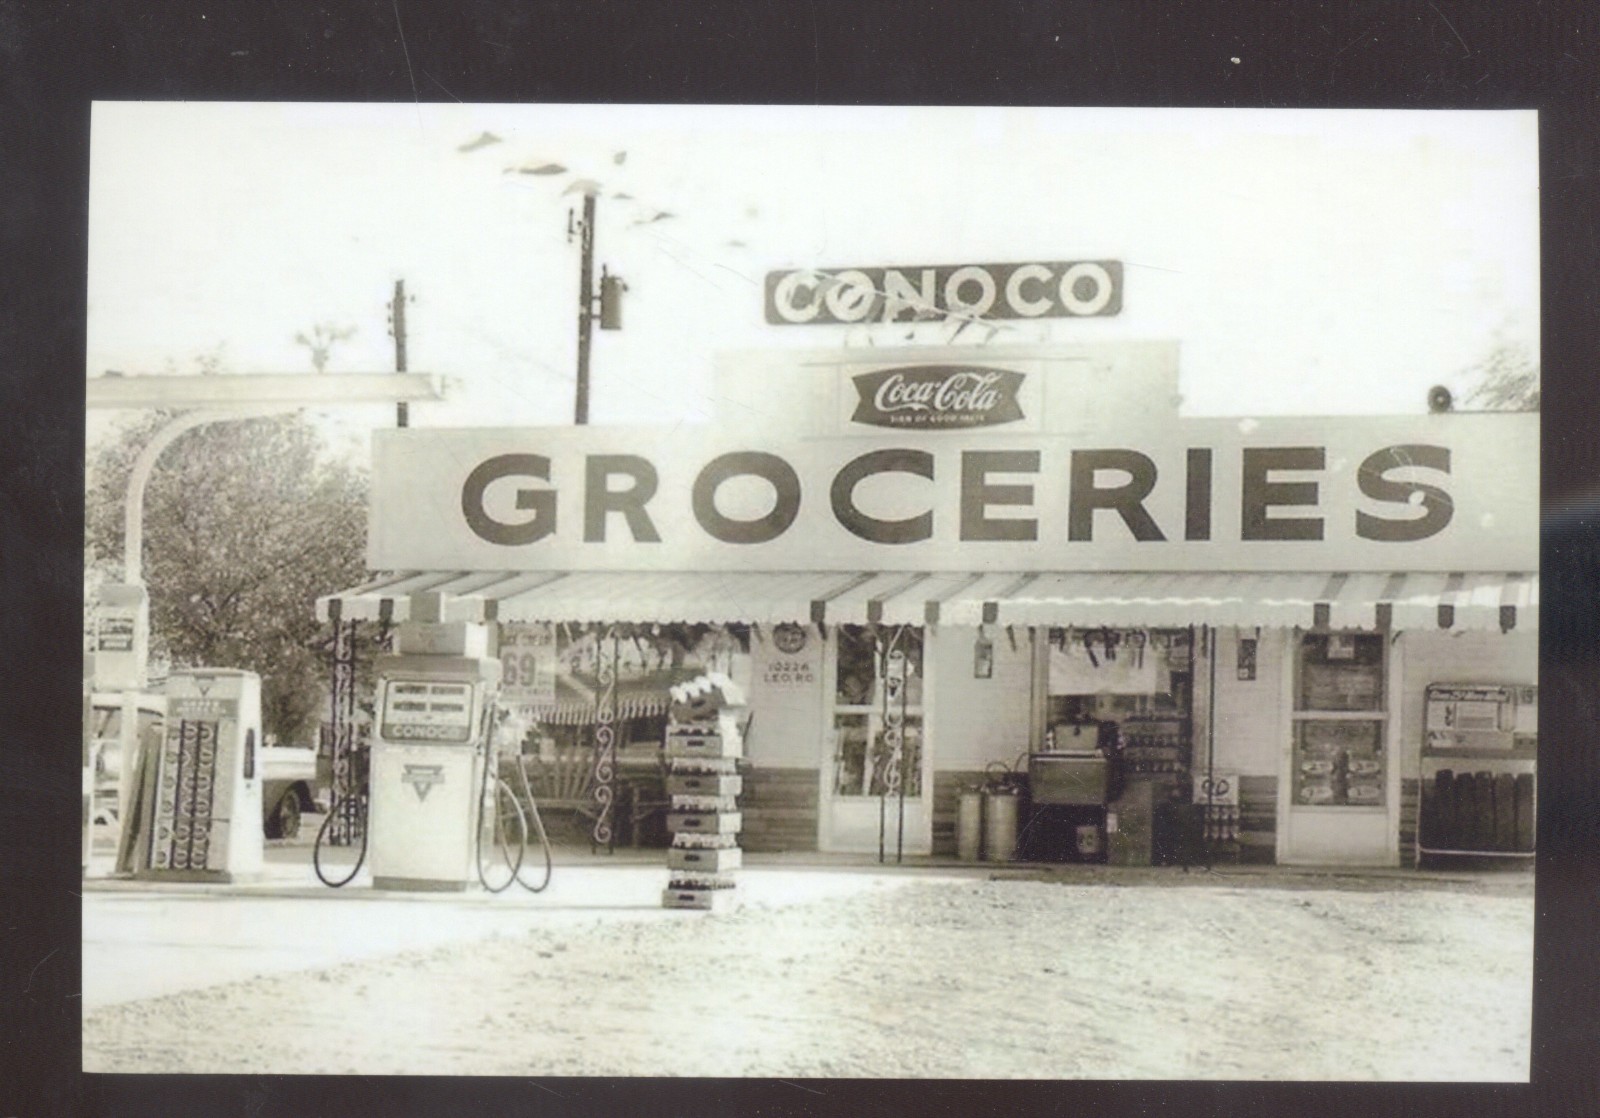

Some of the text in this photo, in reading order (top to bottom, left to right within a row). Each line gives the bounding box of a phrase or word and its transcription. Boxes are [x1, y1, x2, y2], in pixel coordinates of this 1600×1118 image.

[774, 263, 1113, 323] CONOCO
[874, 371, 1002, 412] Coca-Cola
[461, 443, 1455, 548] GROCERIES
[502, 651, 536, 687] 69
[391, 725, 460, 739] CONOCO
